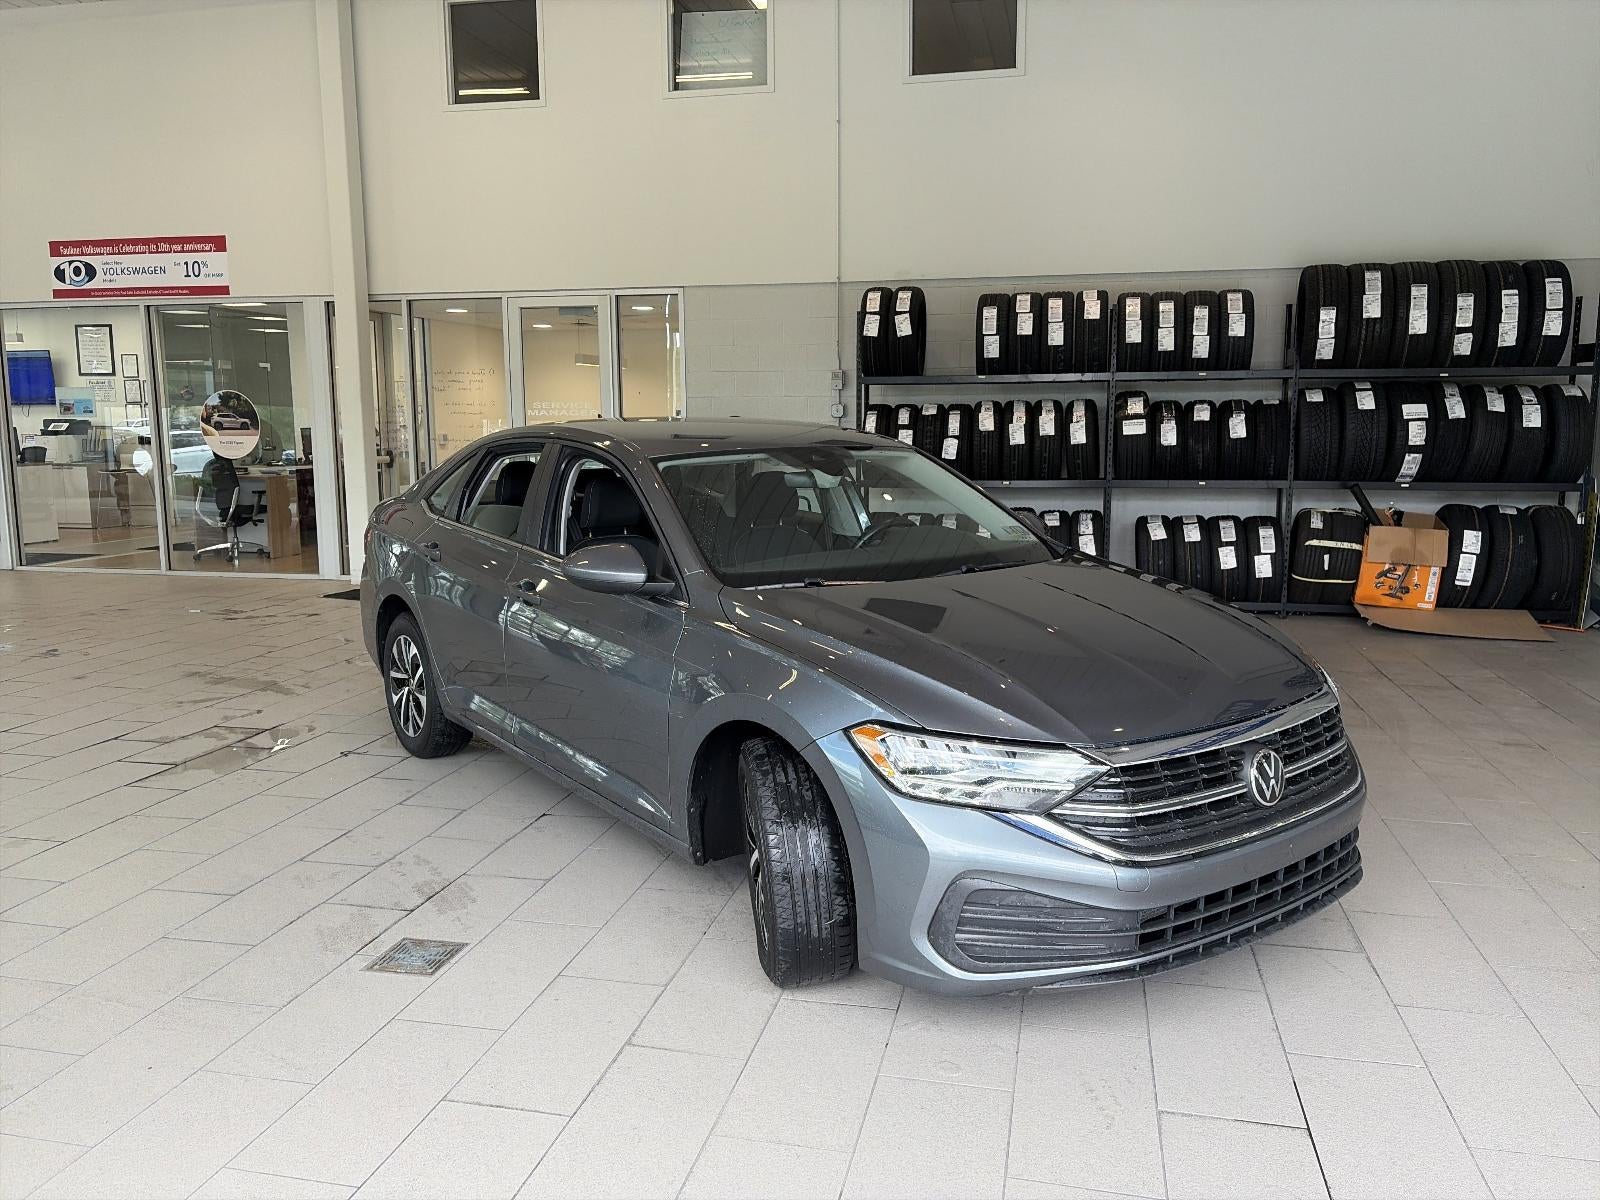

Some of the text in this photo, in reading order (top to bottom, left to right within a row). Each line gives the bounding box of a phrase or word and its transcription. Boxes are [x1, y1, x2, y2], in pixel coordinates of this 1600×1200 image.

[60, 241, 216, 255] Faulkner Volkswagen is Celebrating its 10th year anniversary.
[59, 261, 86, 285] 10
[102, 265, 167, 276] VOLKSWAGEN
[533, 400, 593, 409] SERVICE
[527, 409, 600, 417] MANAGER
